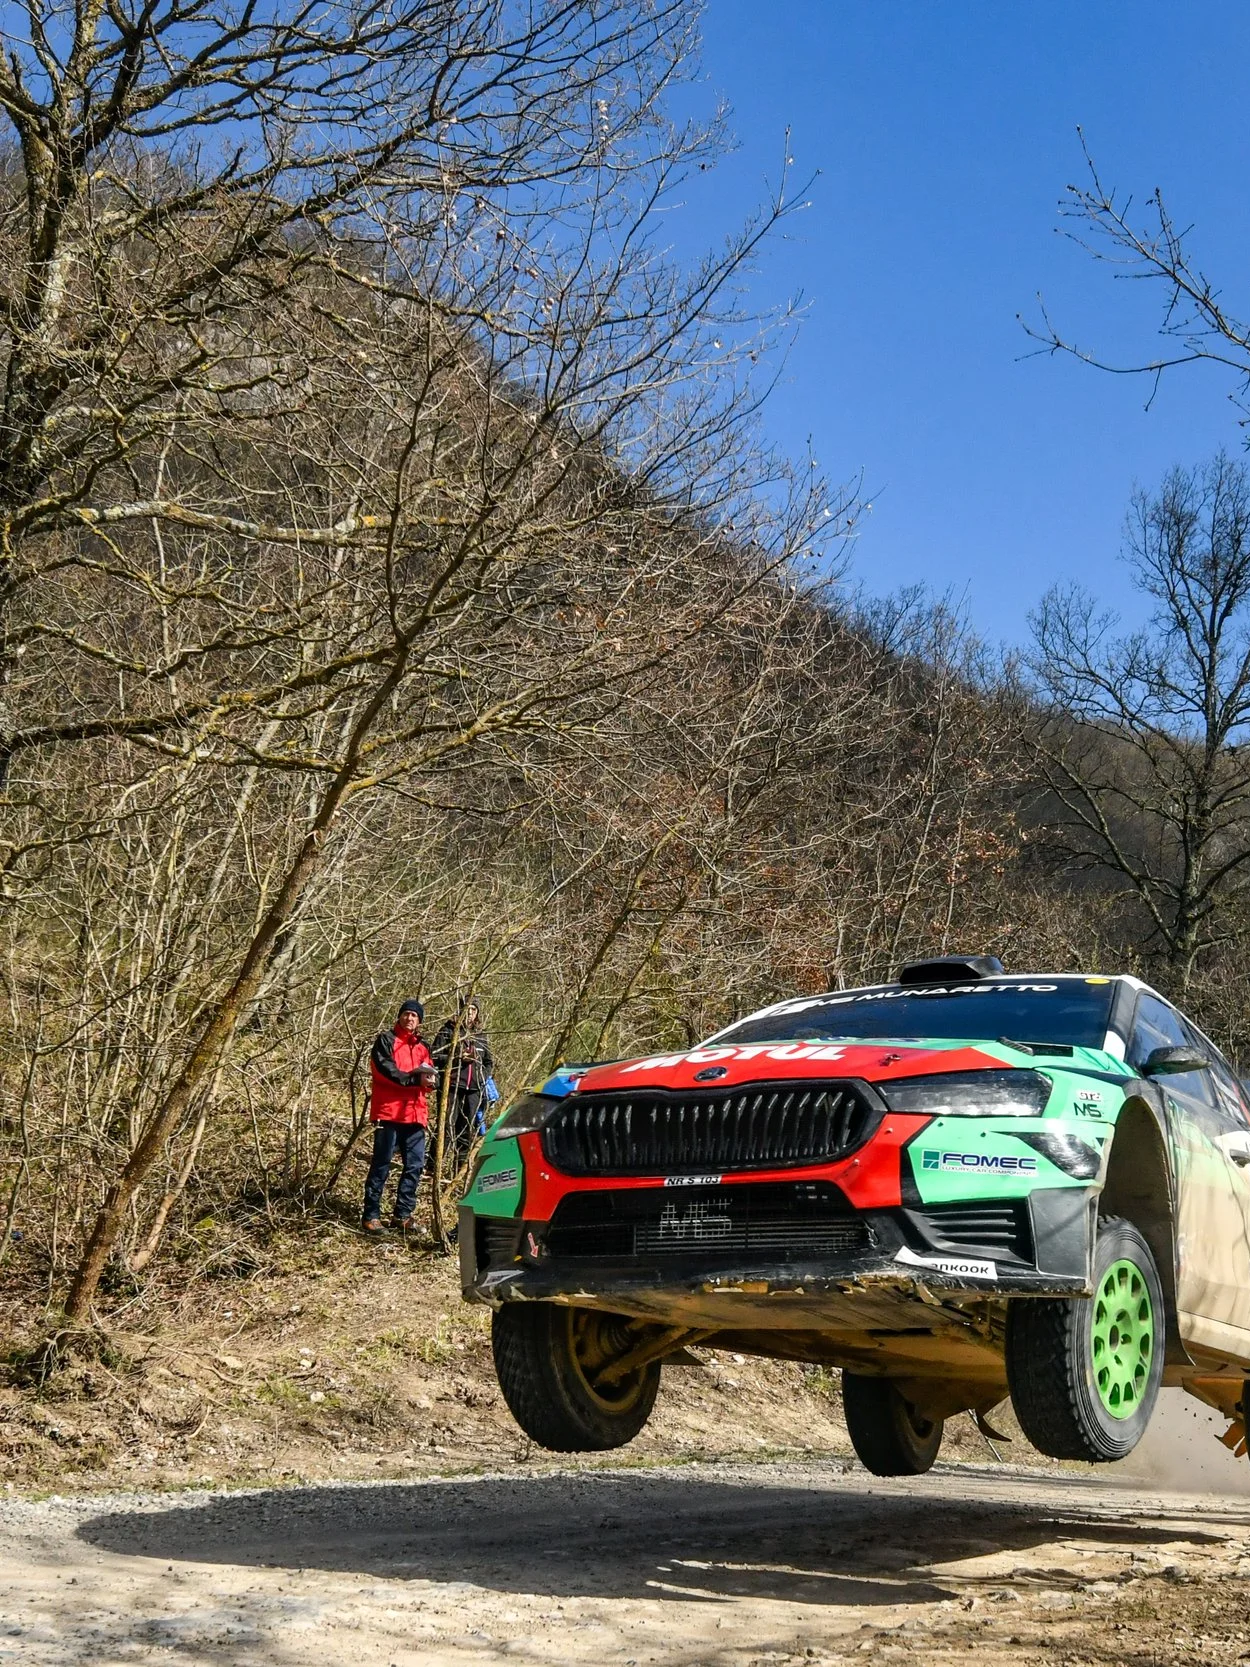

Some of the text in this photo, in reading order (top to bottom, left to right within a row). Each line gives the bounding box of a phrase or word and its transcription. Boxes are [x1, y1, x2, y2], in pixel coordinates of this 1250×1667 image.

[856, 984, 1058, 1002] MUNARETTO
[619, 1043, 848, 1073] MOTUL
[942, 1153, 1036, 1170] FOMEC
[482, 1169, 517, 1187] FOMEC
[667, 1177, 684, 1185] NR
[687, 1176, 695, 1185] S
